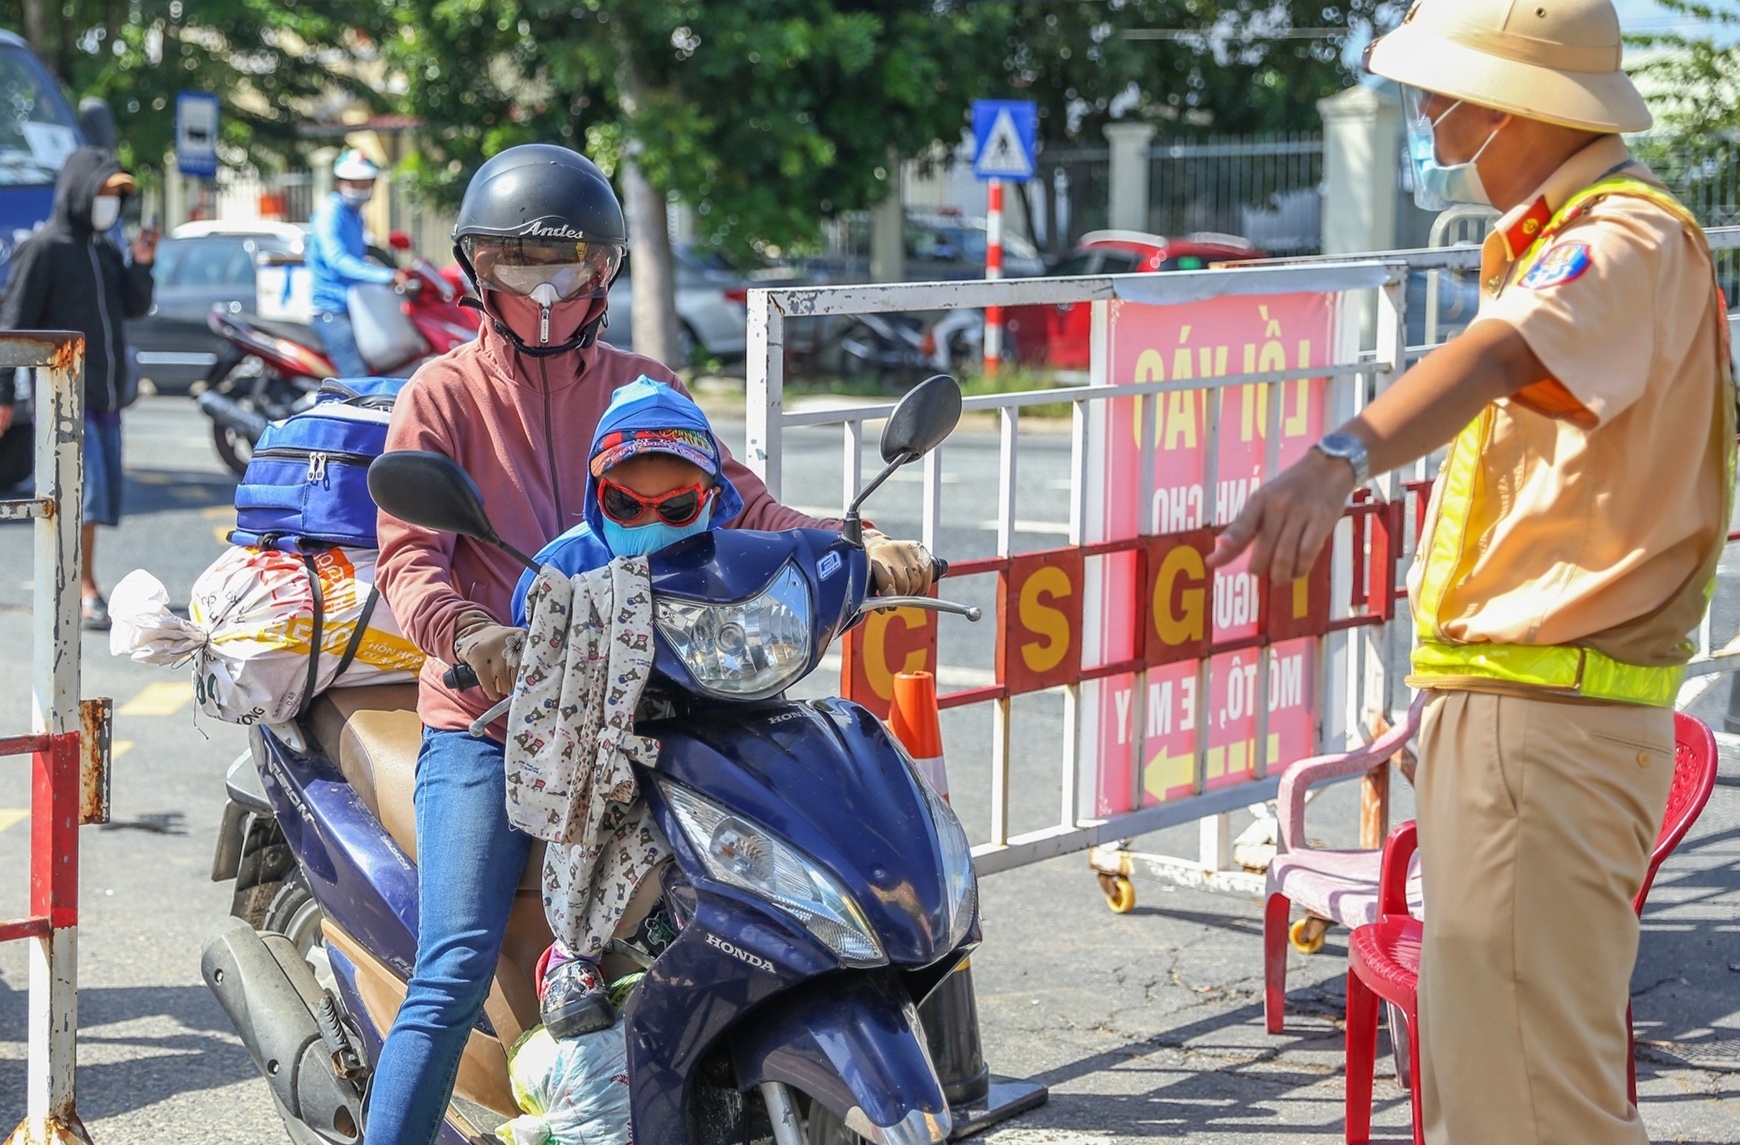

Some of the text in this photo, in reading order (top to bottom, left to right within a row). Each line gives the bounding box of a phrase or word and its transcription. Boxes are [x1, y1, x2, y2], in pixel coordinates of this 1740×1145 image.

[519, 221, 584, 239] Andes
[1018, 565, 1073, 673] S
[1152, 544, 1206, 647] G
[768, 711, 808, 725] HON
[705, 933, 777, 974] HONDA
